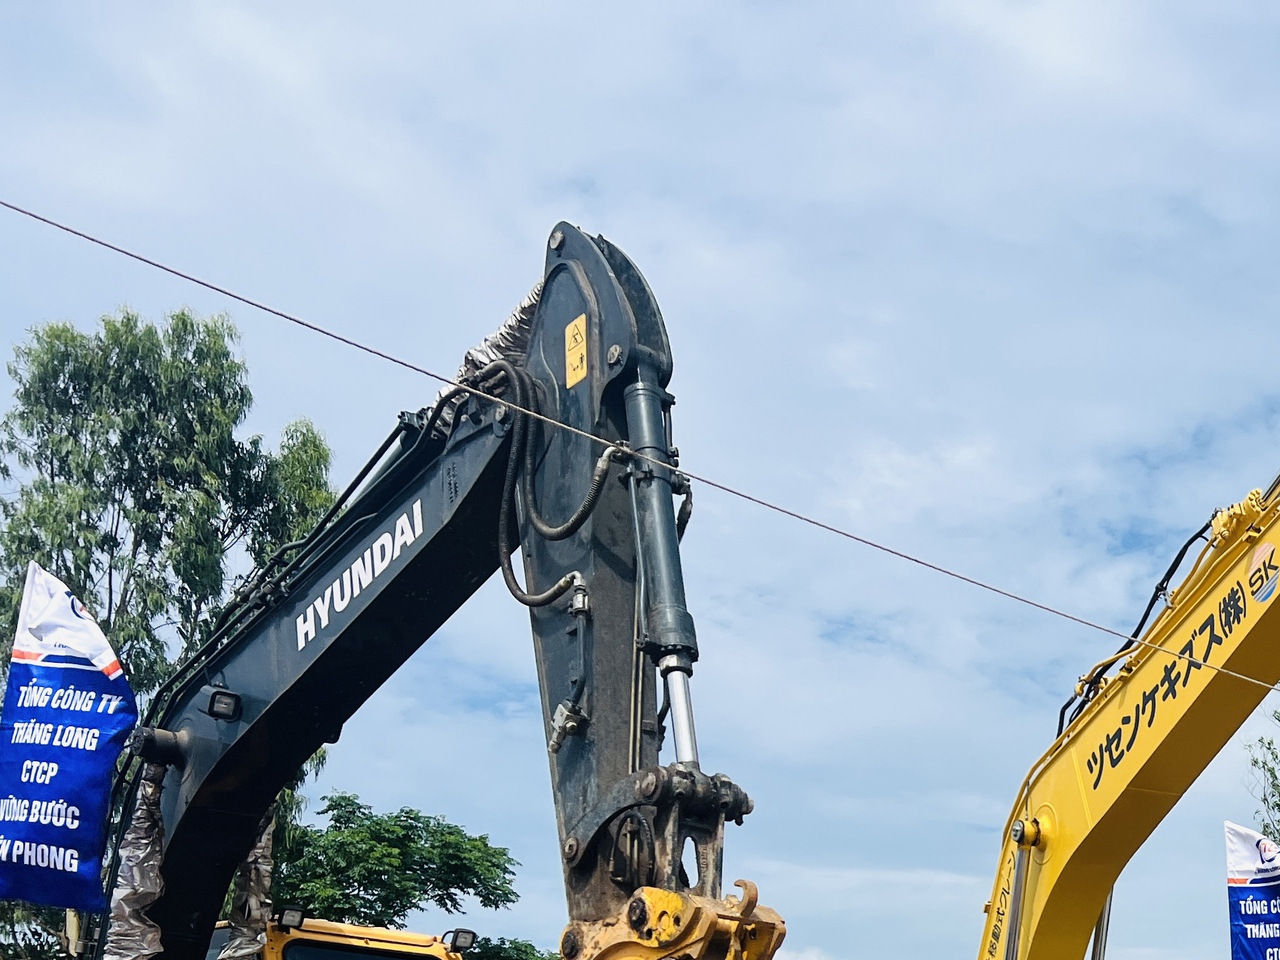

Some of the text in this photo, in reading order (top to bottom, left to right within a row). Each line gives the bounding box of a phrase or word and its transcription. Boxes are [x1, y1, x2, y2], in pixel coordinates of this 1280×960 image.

[296, 498, 424, 652] HYUNDAI
[1248, 548, 1280, 597] SK
[17, 678, 124, 715] TỔNG CÔNG TY
[11, 719, 100, 751] THĂNG LONG
[21, 760, 58, 784] CTCP
[29, 798, 80, 829] BƯỚC
[12, 841, 79, 873] PHONG
[1239, 895, 1268, 915] TỔNG
[1245, 921, 1280, 939] THĂNG
